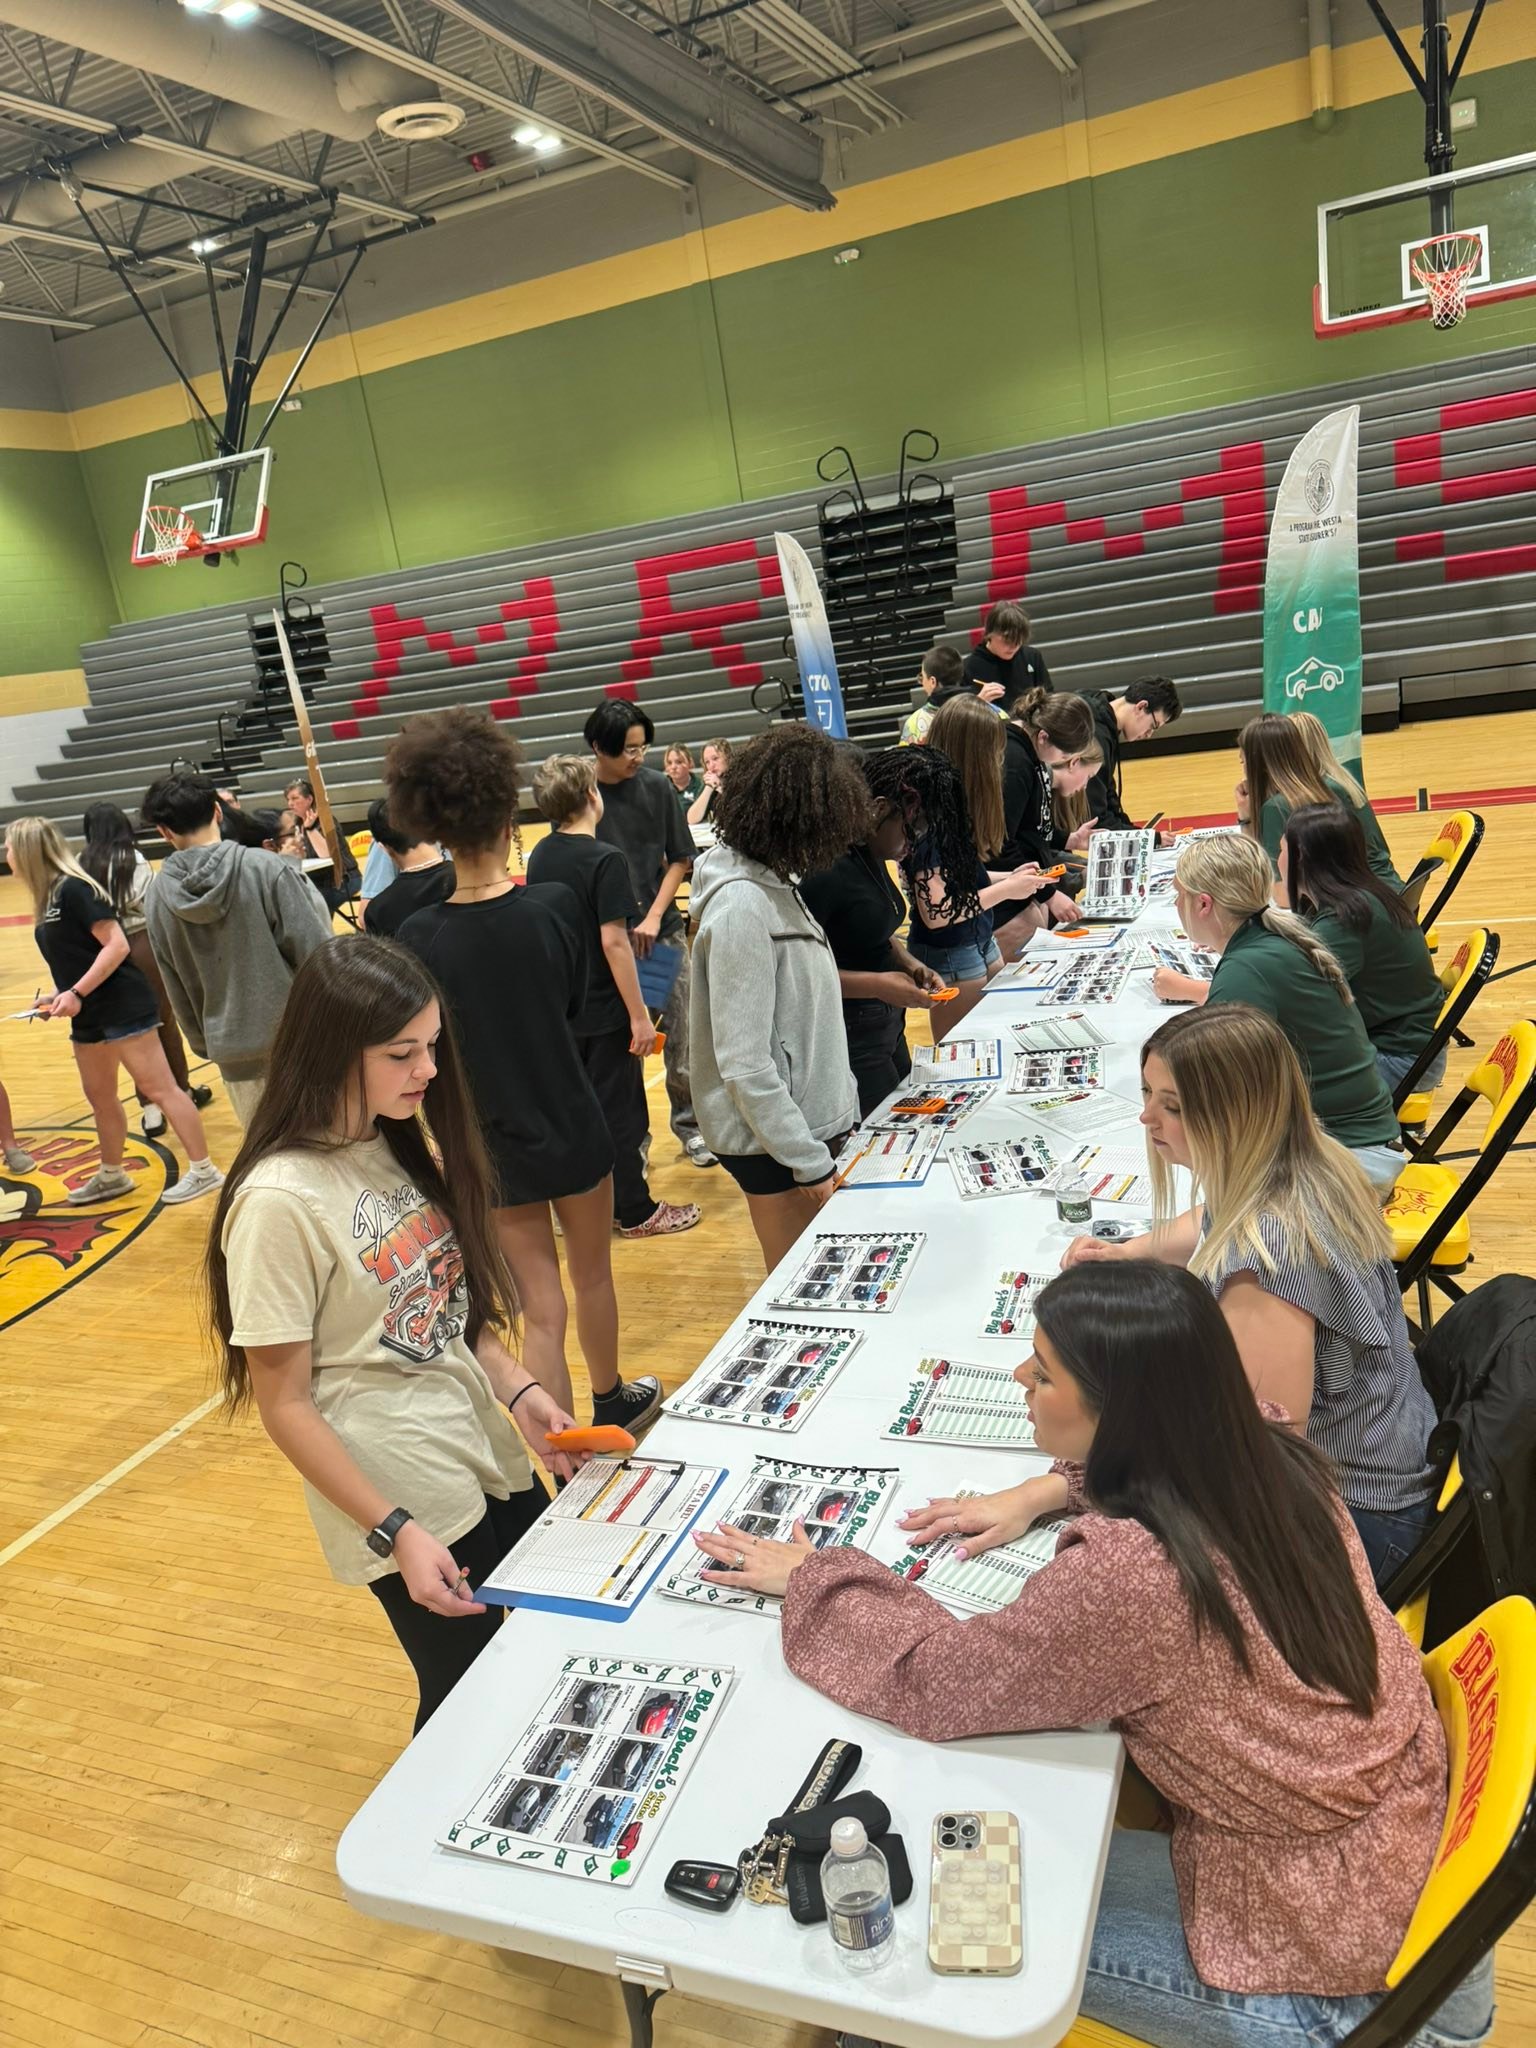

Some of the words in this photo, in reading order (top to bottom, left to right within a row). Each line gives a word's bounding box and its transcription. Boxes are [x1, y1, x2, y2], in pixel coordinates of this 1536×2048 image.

[899, 1380, 925, 1416] Buck's
[888, 1415, 911, 1435] Big
[856, 1489, 881, 1514] Big
[690, 1688, 716, 1724] Big
[654, 1725, 699, 1792] Buck's
[637, 1791, 659, 1820] Sales
[646, 1791, 668, 1819] Auto
